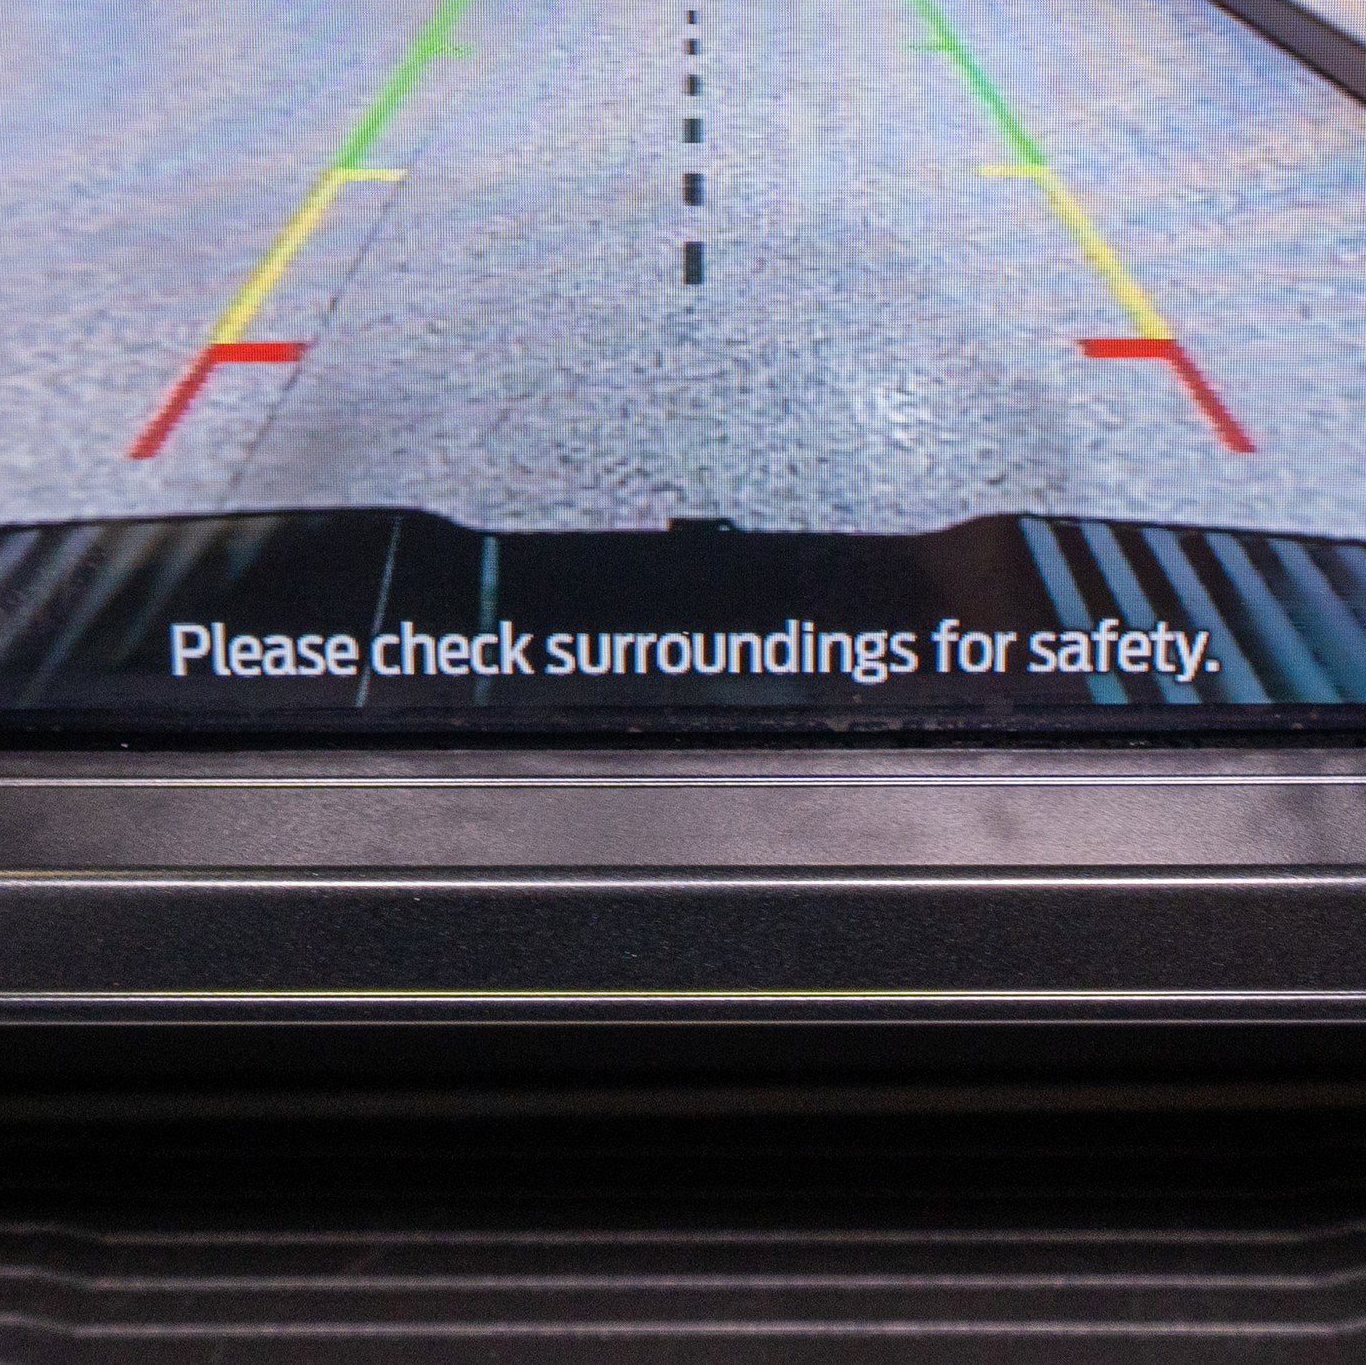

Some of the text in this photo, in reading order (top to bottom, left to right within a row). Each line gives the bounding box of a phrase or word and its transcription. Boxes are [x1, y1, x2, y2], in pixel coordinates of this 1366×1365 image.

[171, 619, 1221, 684] Please check surroundings for safety.
